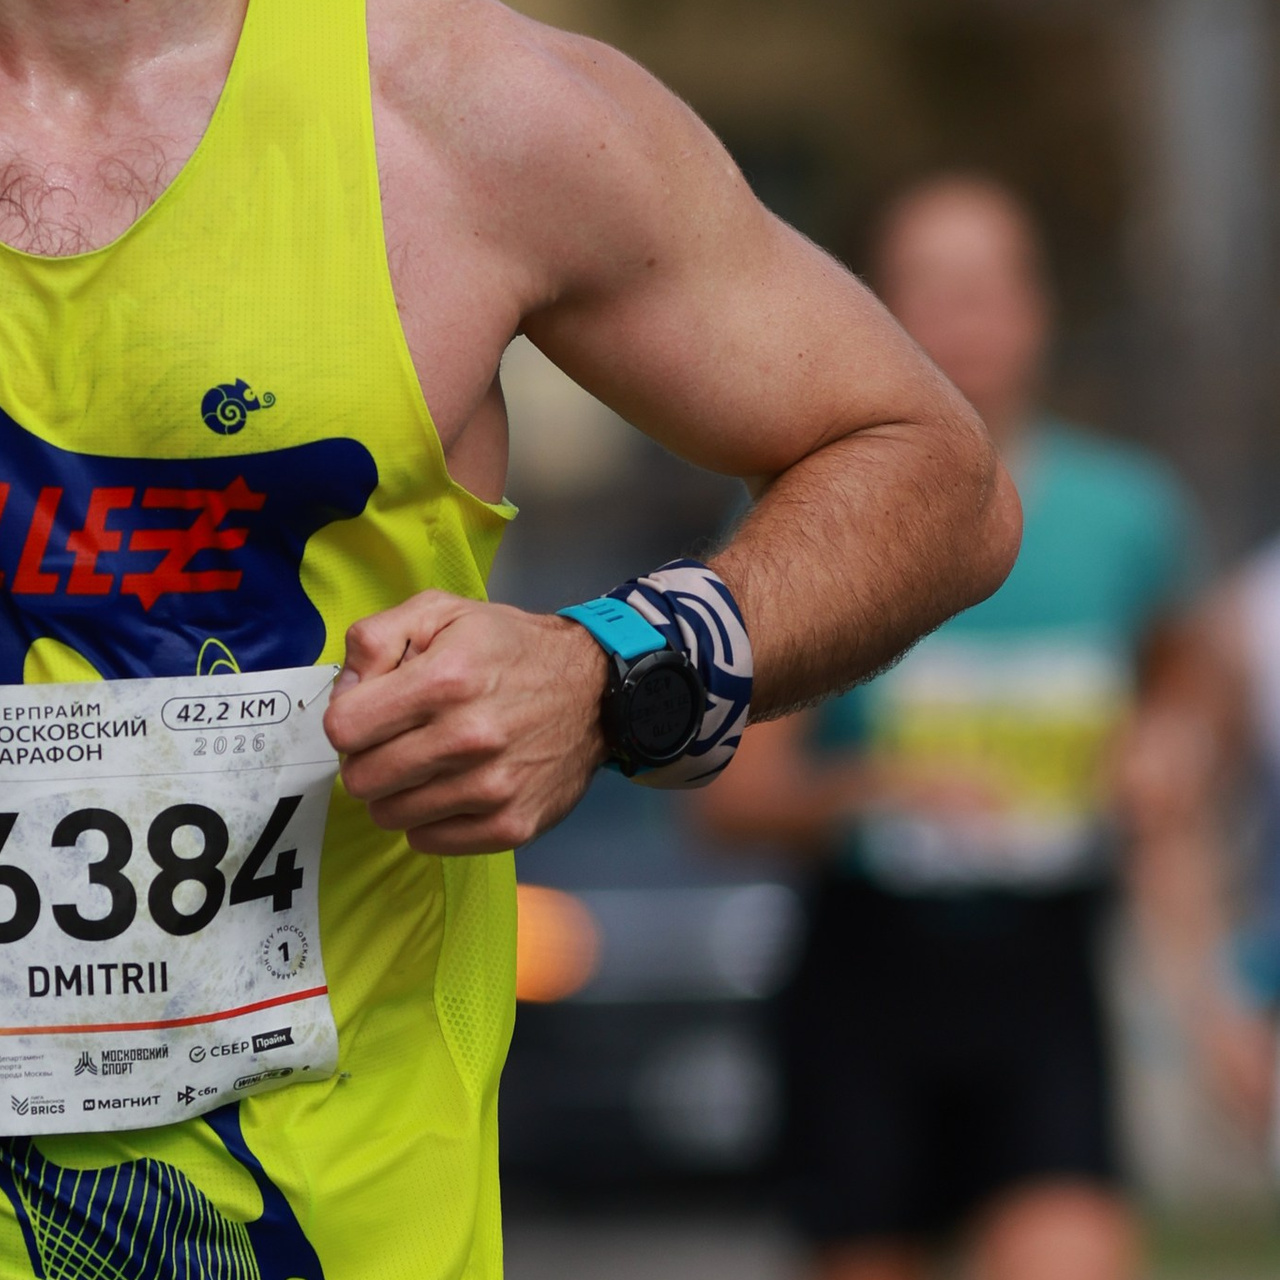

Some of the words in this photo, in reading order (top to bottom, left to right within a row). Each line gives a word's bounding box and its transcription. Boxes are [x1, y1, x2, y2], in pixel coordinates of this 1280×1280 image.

[176, 702, 229, 724] 42,2
[193, 733, 266, 756] 2026
[278, 941, 290, 962] 1
[28, 961, 168, 998] DMITRII
[101, 1044, 169, 1062] МОСКОВСКИЙ
[210, 1041, 250, 1058] СБЕР
[255, 1034, 287, 1049] Прайм
[101, 1062, 134, 1076] СПОРТ
[30, 1104, 66, 1116] BRICS
